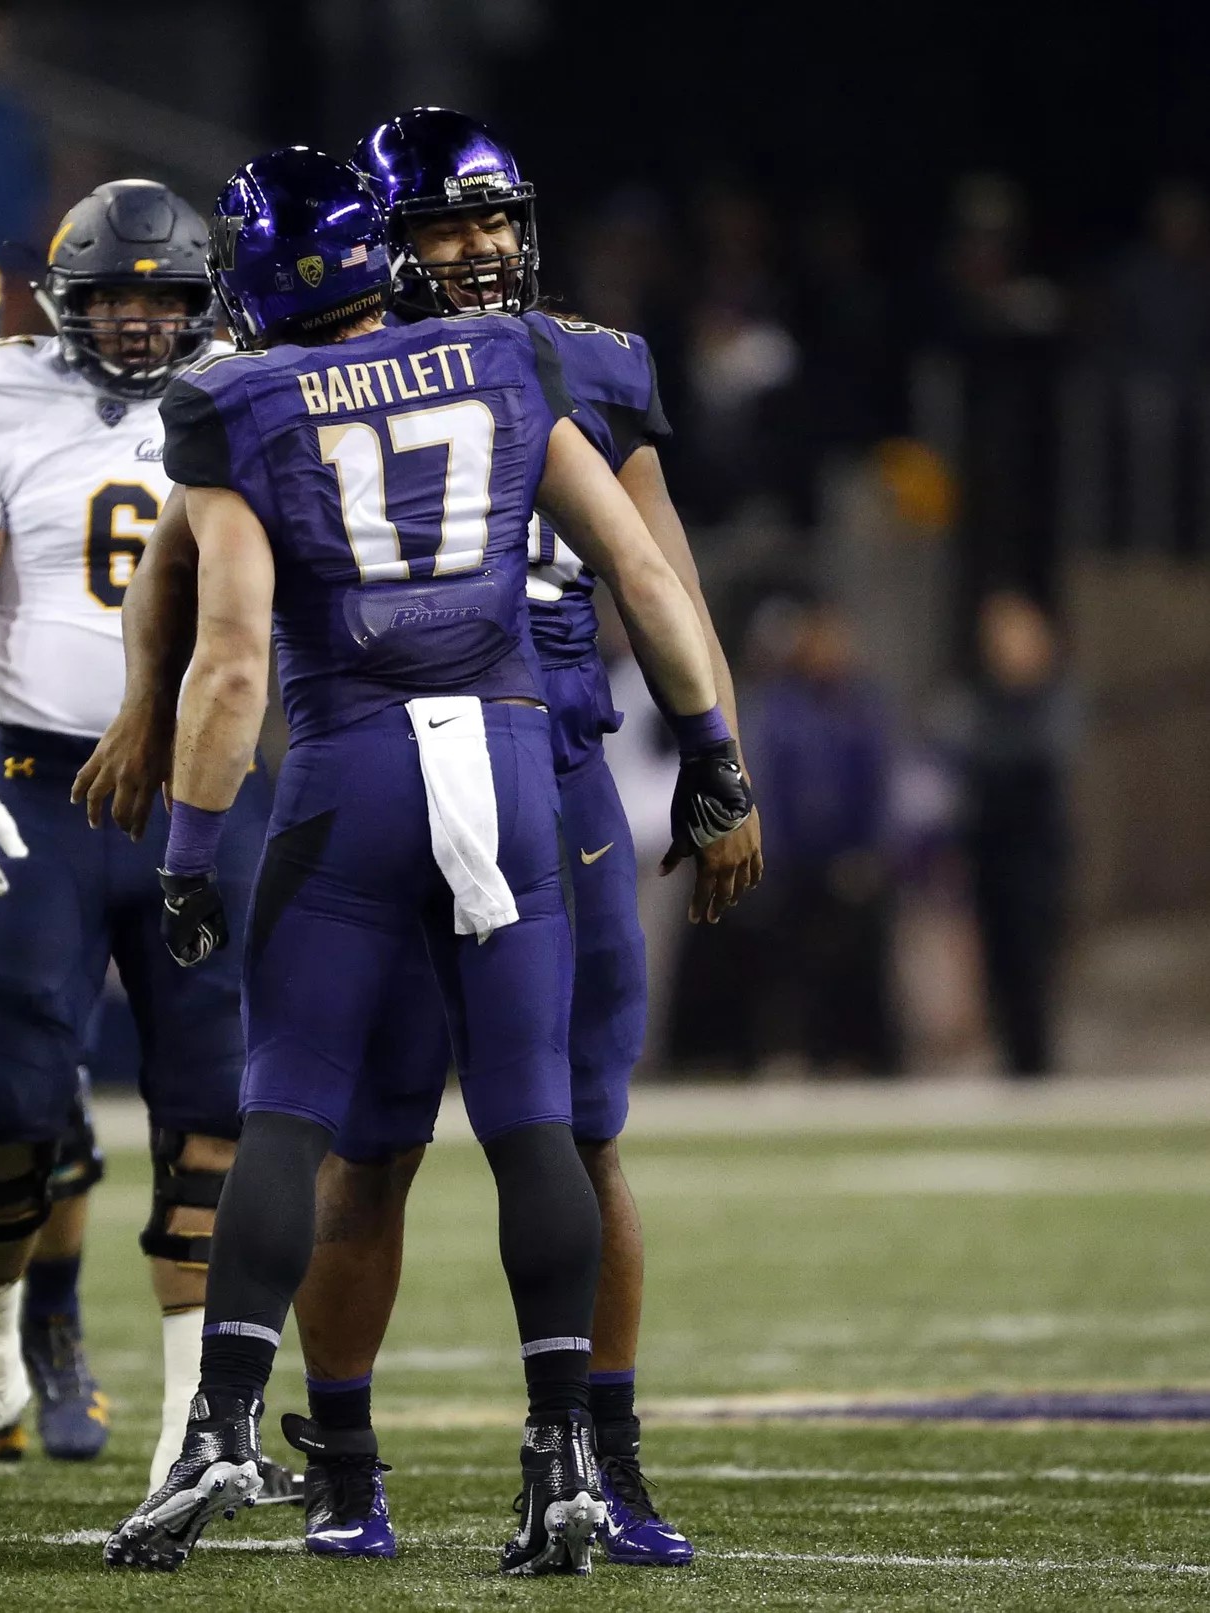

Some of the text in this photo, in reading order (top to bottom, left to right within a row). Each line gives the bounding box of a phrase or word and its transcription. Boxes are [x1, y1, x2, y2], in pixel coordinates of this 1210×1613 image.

[301, 292, 382, 330] WASHINGTON
[297, 343, 476, 416] BARTLETT
[316, 399, 496, 585] 17
